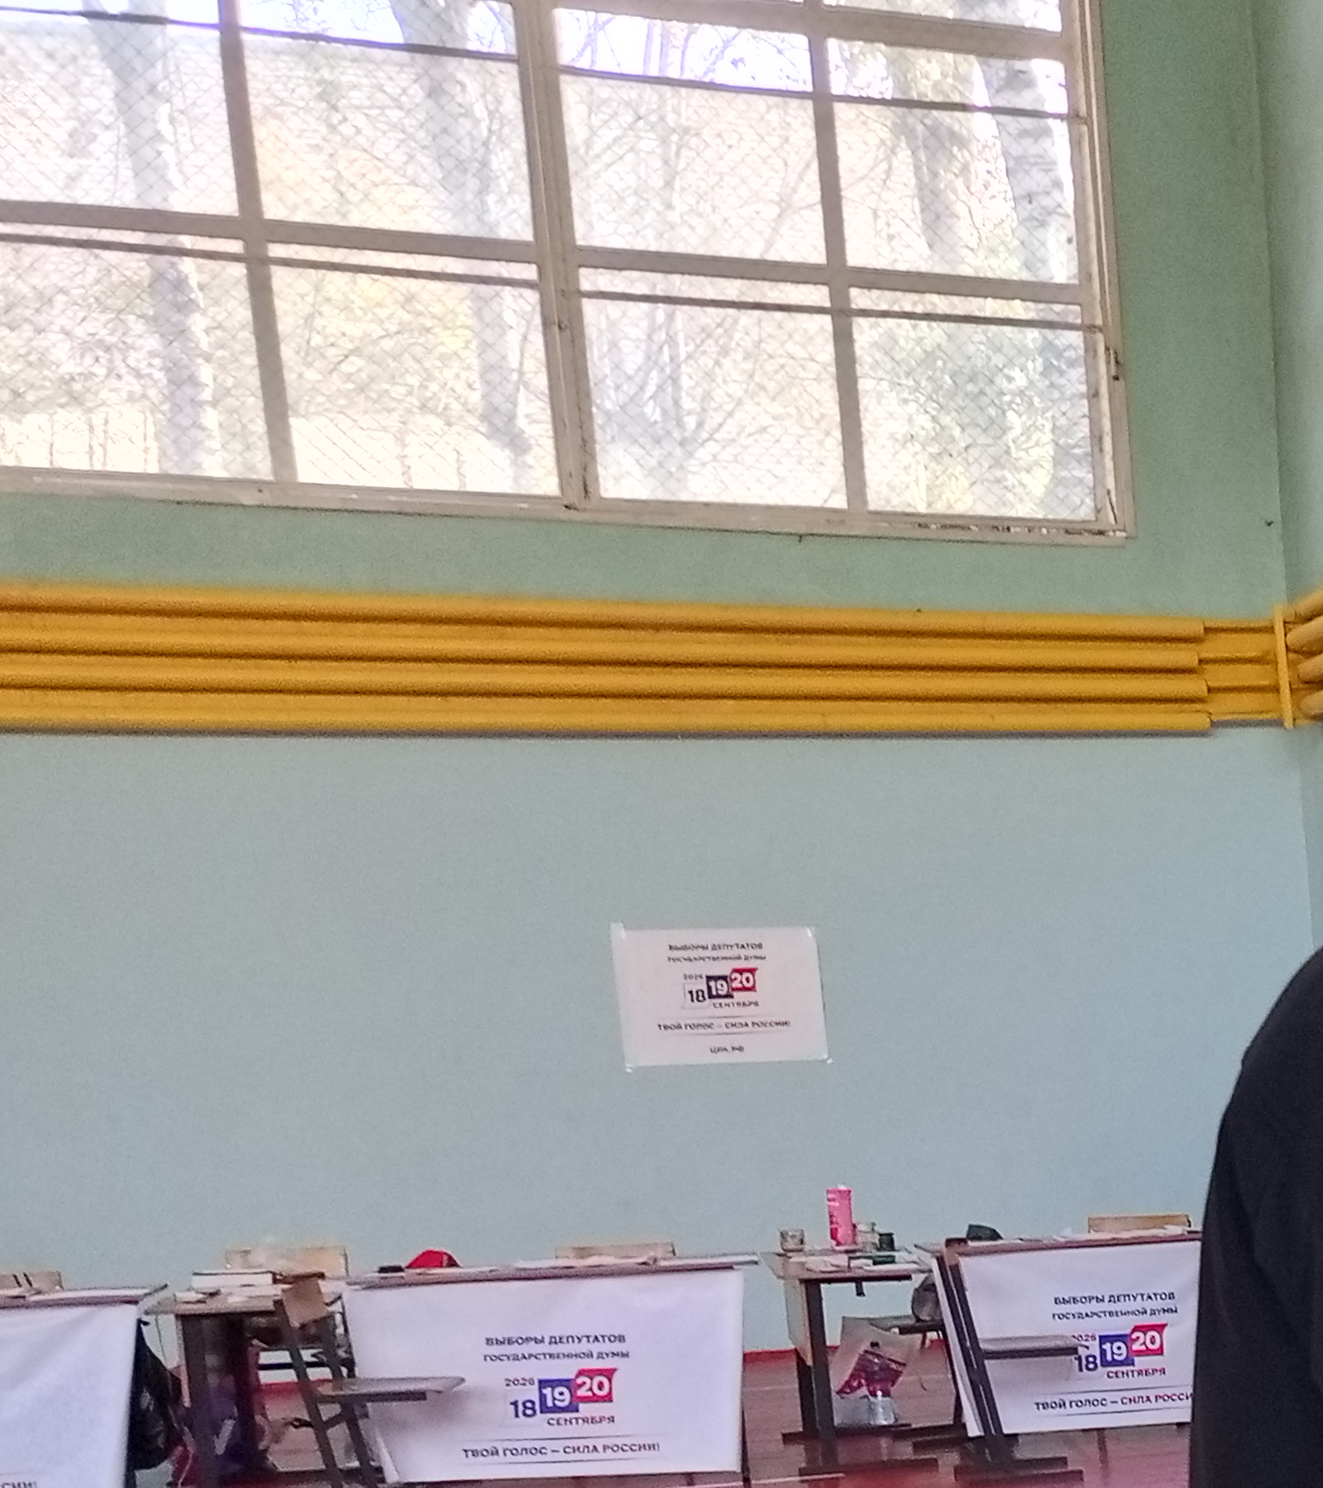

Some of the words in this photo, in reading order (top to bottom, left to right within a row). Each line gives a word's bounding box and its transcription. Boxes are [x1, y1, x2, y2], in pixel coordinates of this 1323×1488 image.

[688, 989, 706, 1003] 18
[708, 980, 728, 995] 19
[731, 972, 754, 988] 20
[1054, 1294, 1105, 1305] ВЫБОРЫ
[1107, 1292, 1176, 1304] ДЕПУТАТОВ
[1052, 1307, 1148, 1320] ГОСУДАРСТВЕННОЙ
[1149, 1305, 1178, 1316] ДУМЫ
[485, 1336, 545, 1346] ВЫБОРЫ
[548, 1334, 626, 1345] ДЕПУТАТОВ
[483, 1350, 593, 1362] ГОСУДАРСТВЕННОЙ
[595, 1350, 630, 1360] ДУМЫ
[1074, 1355, 1098, 1372] 18
[1102, 1341, 1128, 1361] 19
[1131, 1331, 1161, 1350] 20
[1106, 1367, 1166, 1379] СЕНТЯБРЯ
[504, 1377, 535, 1387] 2026
[510, 1399, 537, 1418] 18
[542, 1386, 571, 1408] 19
[575, 1375, 610, 1397] 20
[1034, 1399, 1067, 1411] ТВОЙ
[1069, 1397, 1108, 1409] ГОЛОС
[1121, 1395, 1153, 1406] СИЛА
[547, 1415, 615, 1427] СЕНТЯБРЯ
[462, 1445, 499, 1459] ТВОЙ
[503, 1446, 547, 1457] ГОЛОС
[563, 1444, 599, 1455] СИЛА
[602, 1442, 660, 1454] РОССИИ!
